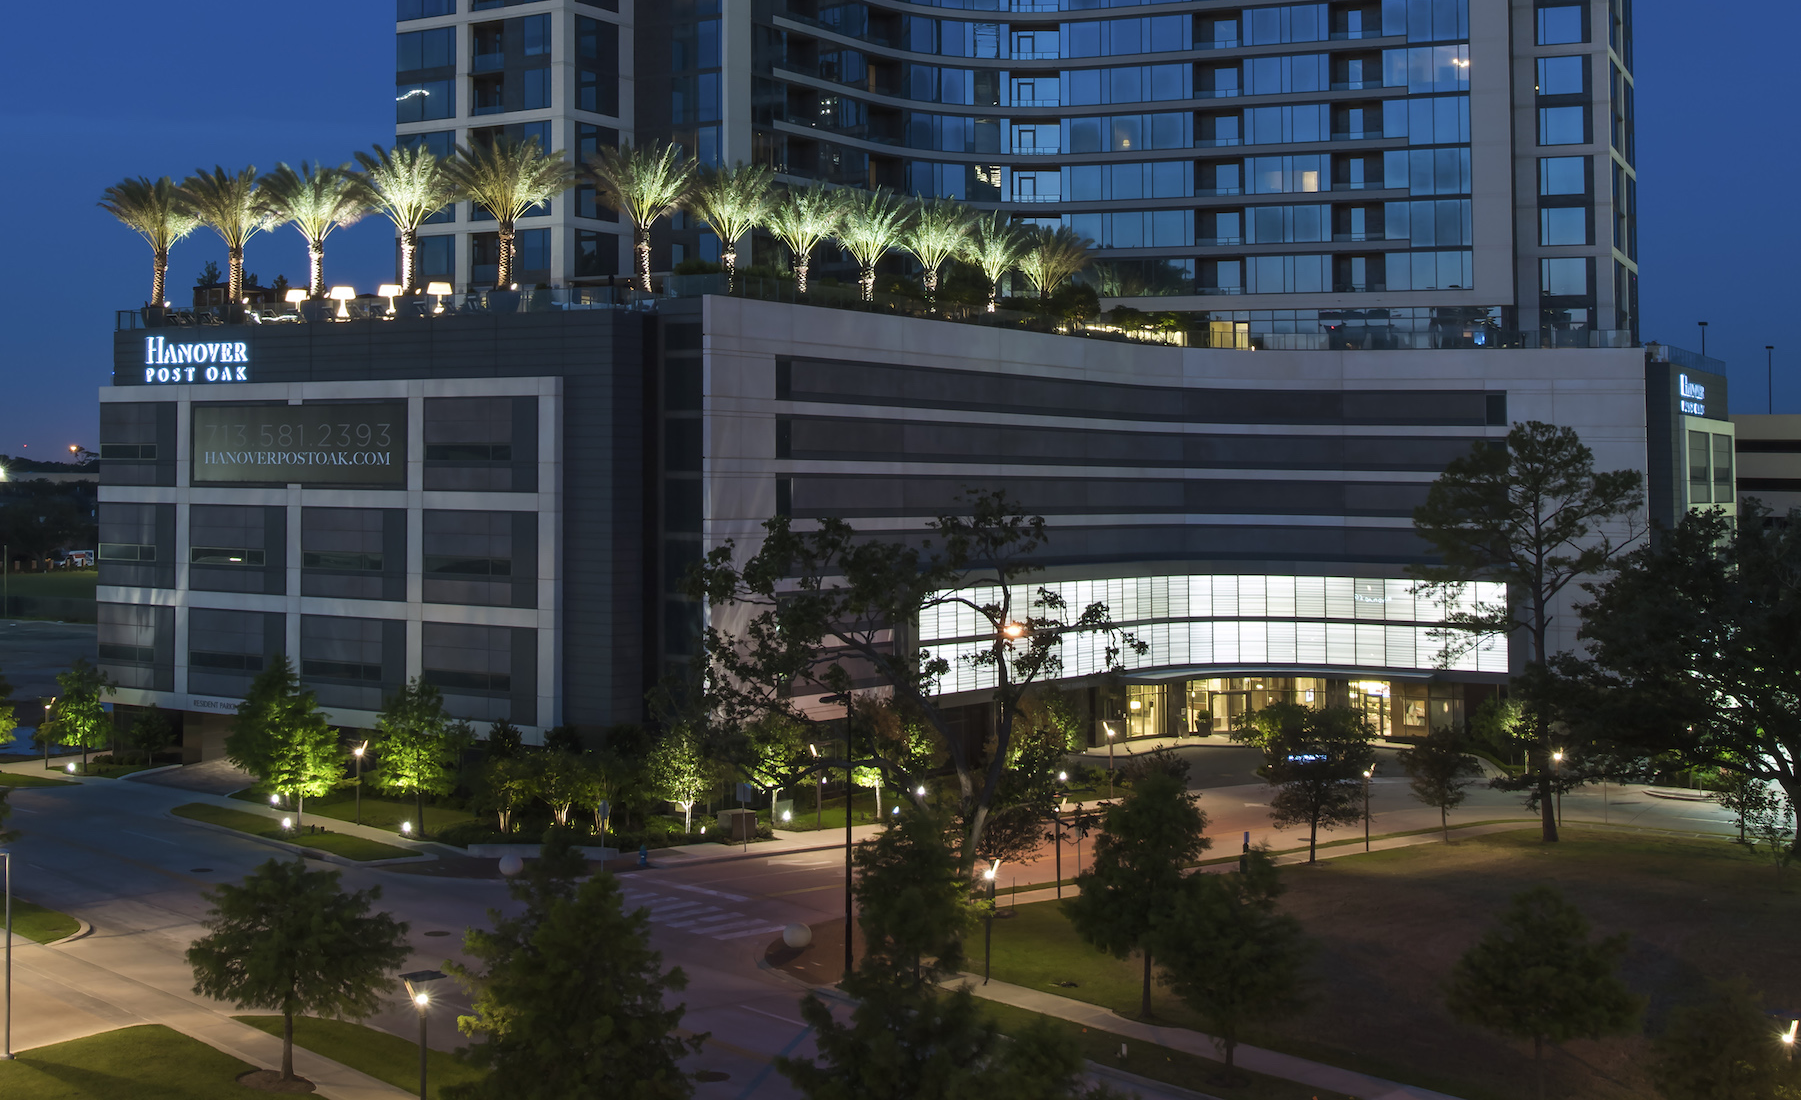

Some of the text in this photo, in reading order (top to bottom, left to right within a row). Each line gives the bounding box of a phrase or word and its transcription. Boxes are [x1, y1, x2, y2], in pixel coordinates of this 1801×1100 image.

[145, 336, 249, 364] HANOVER
[145, 366, 248, 382] POST OAK
[205, 423, 391, 447] 713.581.2393
[204, 451, 391, 466] HANOVERPOSTOAK.COM
[193, 699, 219, 708] RESIDENT
